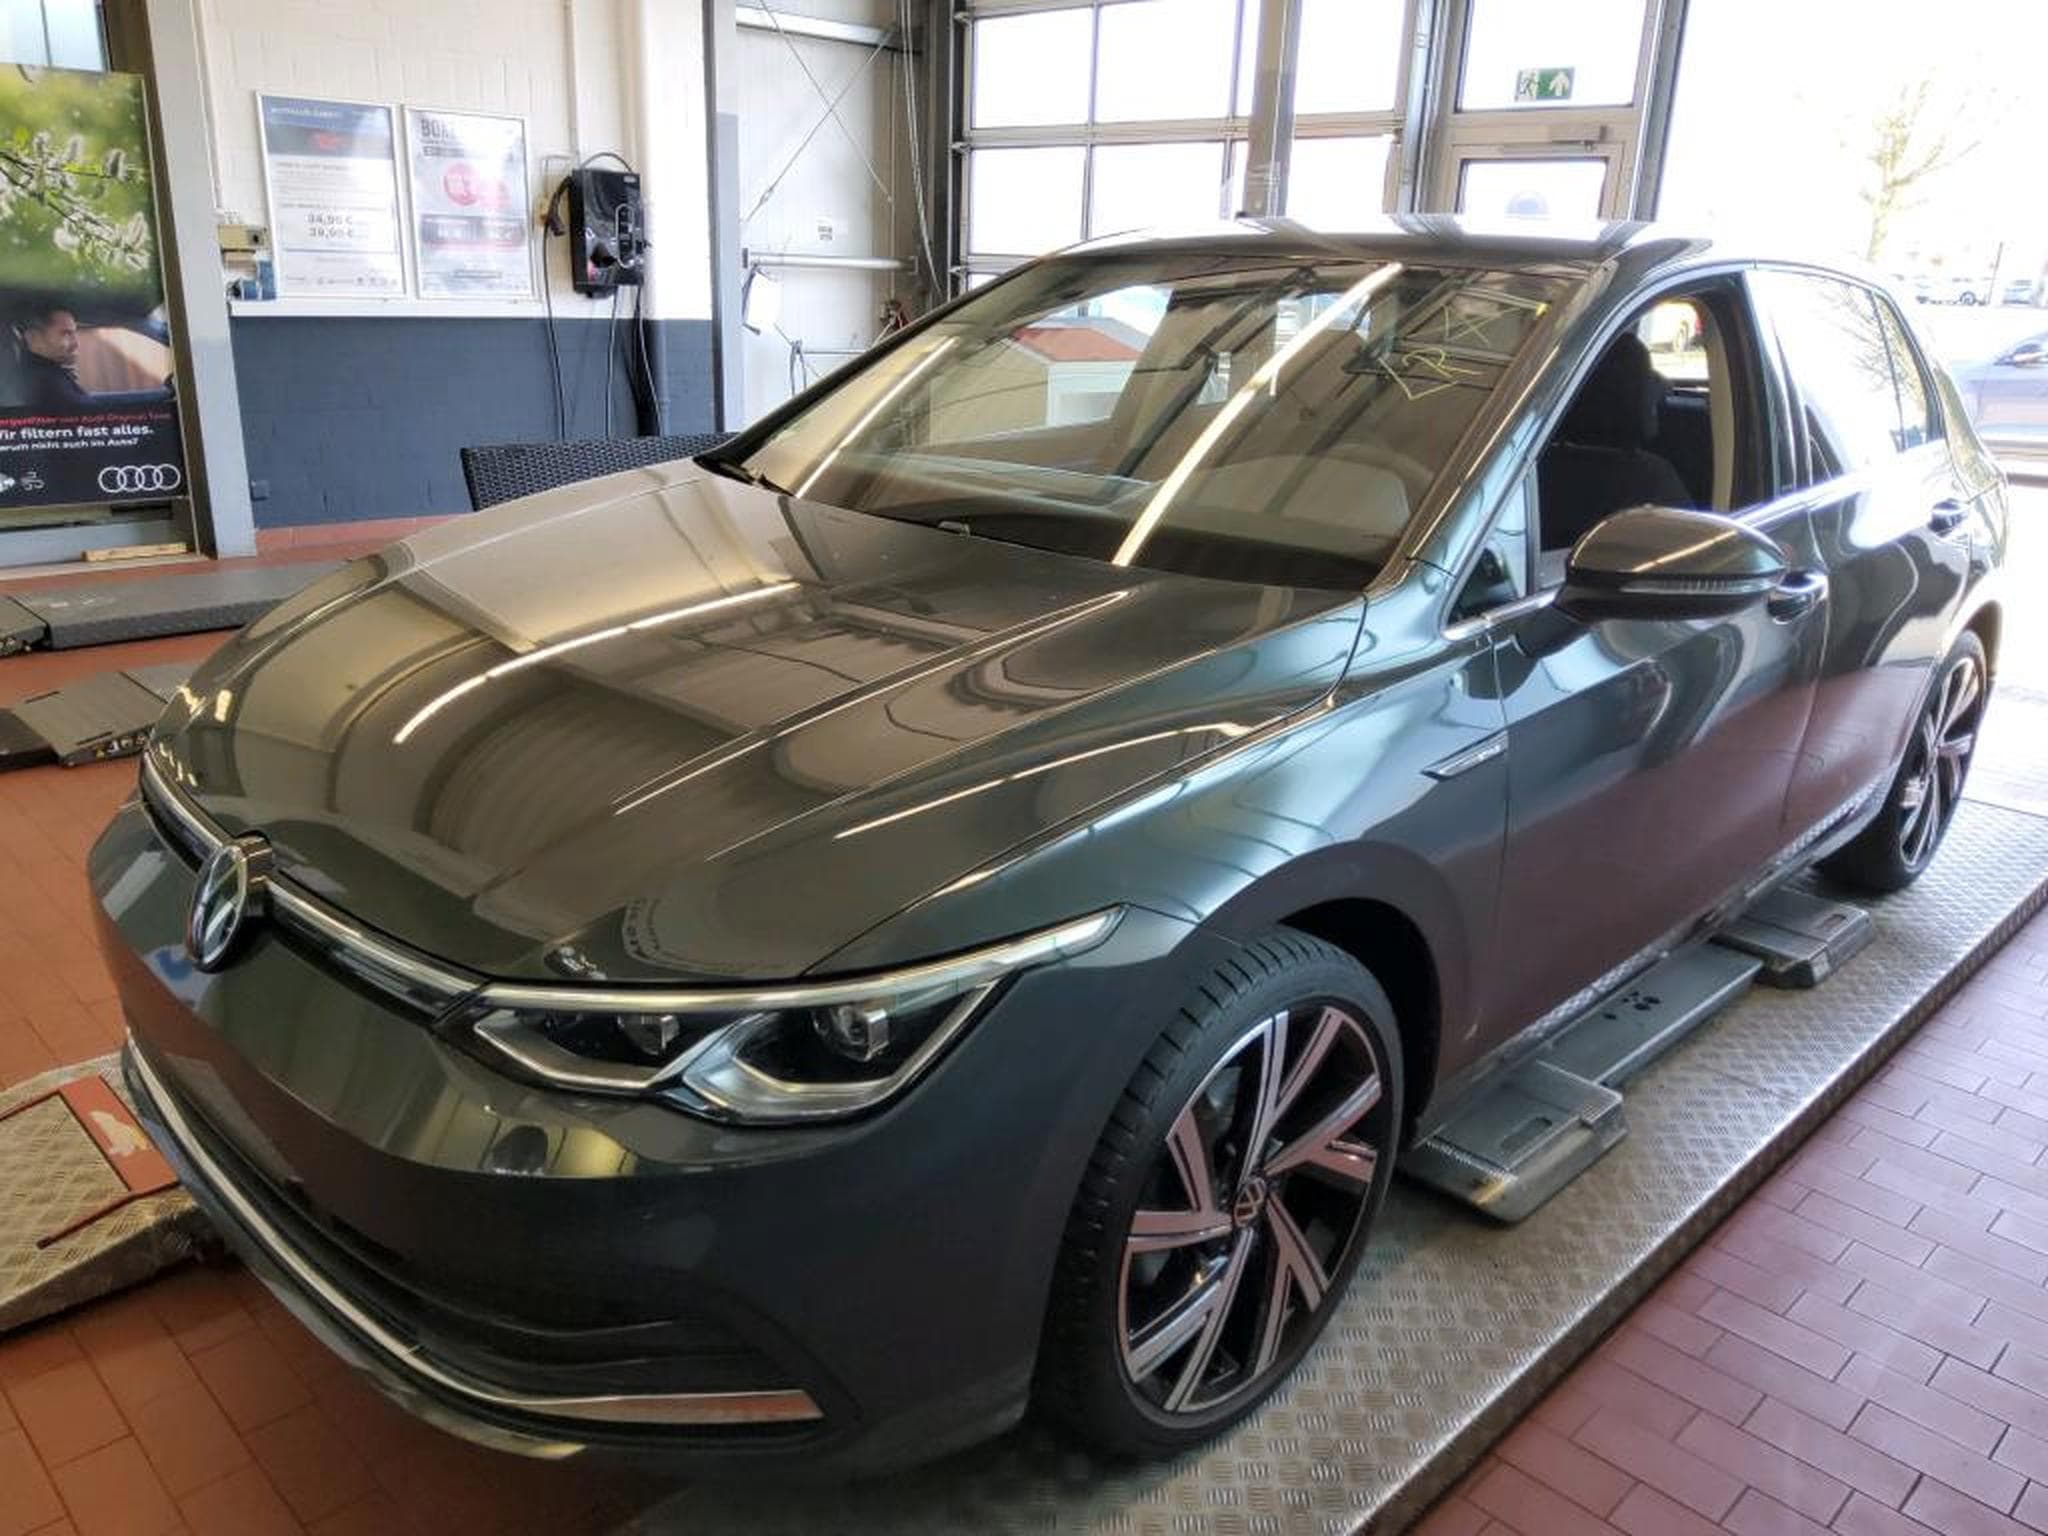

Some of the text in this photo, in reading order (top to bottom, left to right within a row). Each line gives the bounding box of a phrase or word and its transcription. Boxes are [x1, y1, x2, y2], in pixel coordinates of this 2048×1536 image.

[0, 424, 154, 440] ir filtern fast alles.
[63, 440, 89, 449] auch
